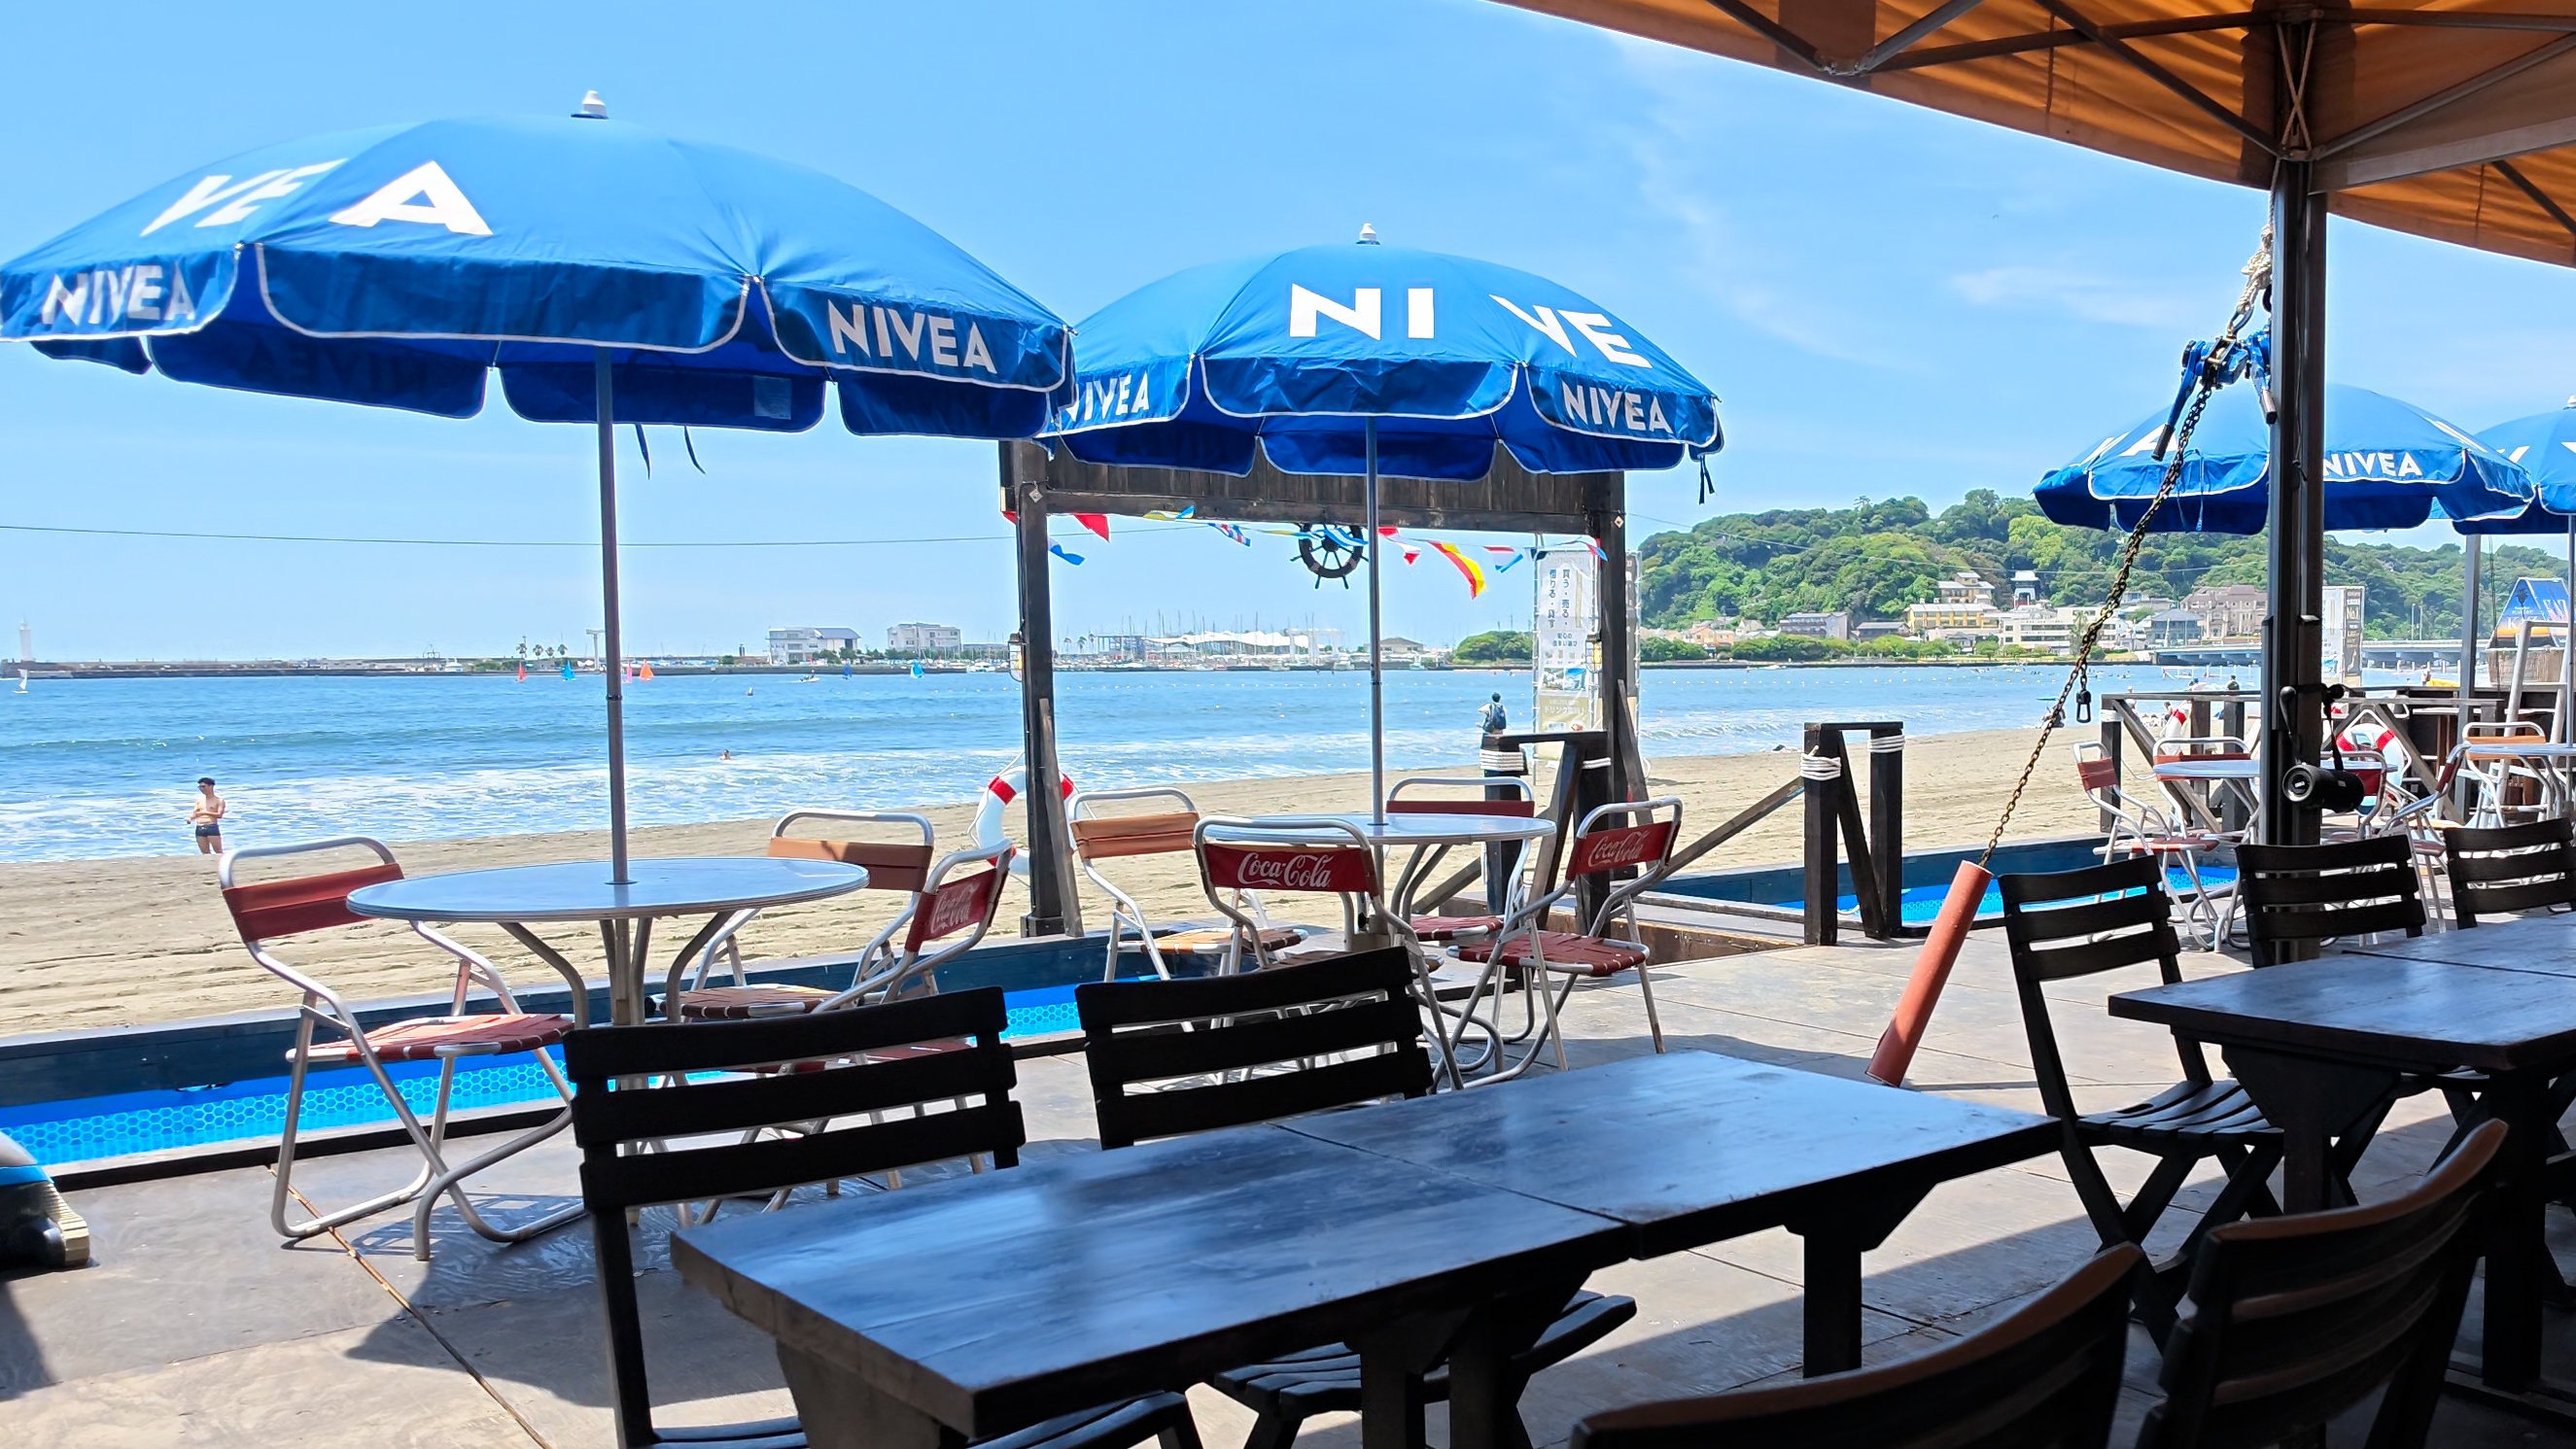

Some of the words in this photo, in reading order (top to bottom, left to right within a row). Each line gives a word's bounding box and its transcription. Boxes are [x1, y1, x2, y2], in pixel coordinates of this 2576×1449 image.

[42, 264, 195, 331] NIVEA
[827, 299, 997, 374] NIVEA
[1561, 380, 1674, 434] NIVEA
[2323, 452, 2423, 477] NIVEA
[1237, 852, 1336, 888] Coca-Cola
[1587, 830, 1650, 867] Coca-Cola
